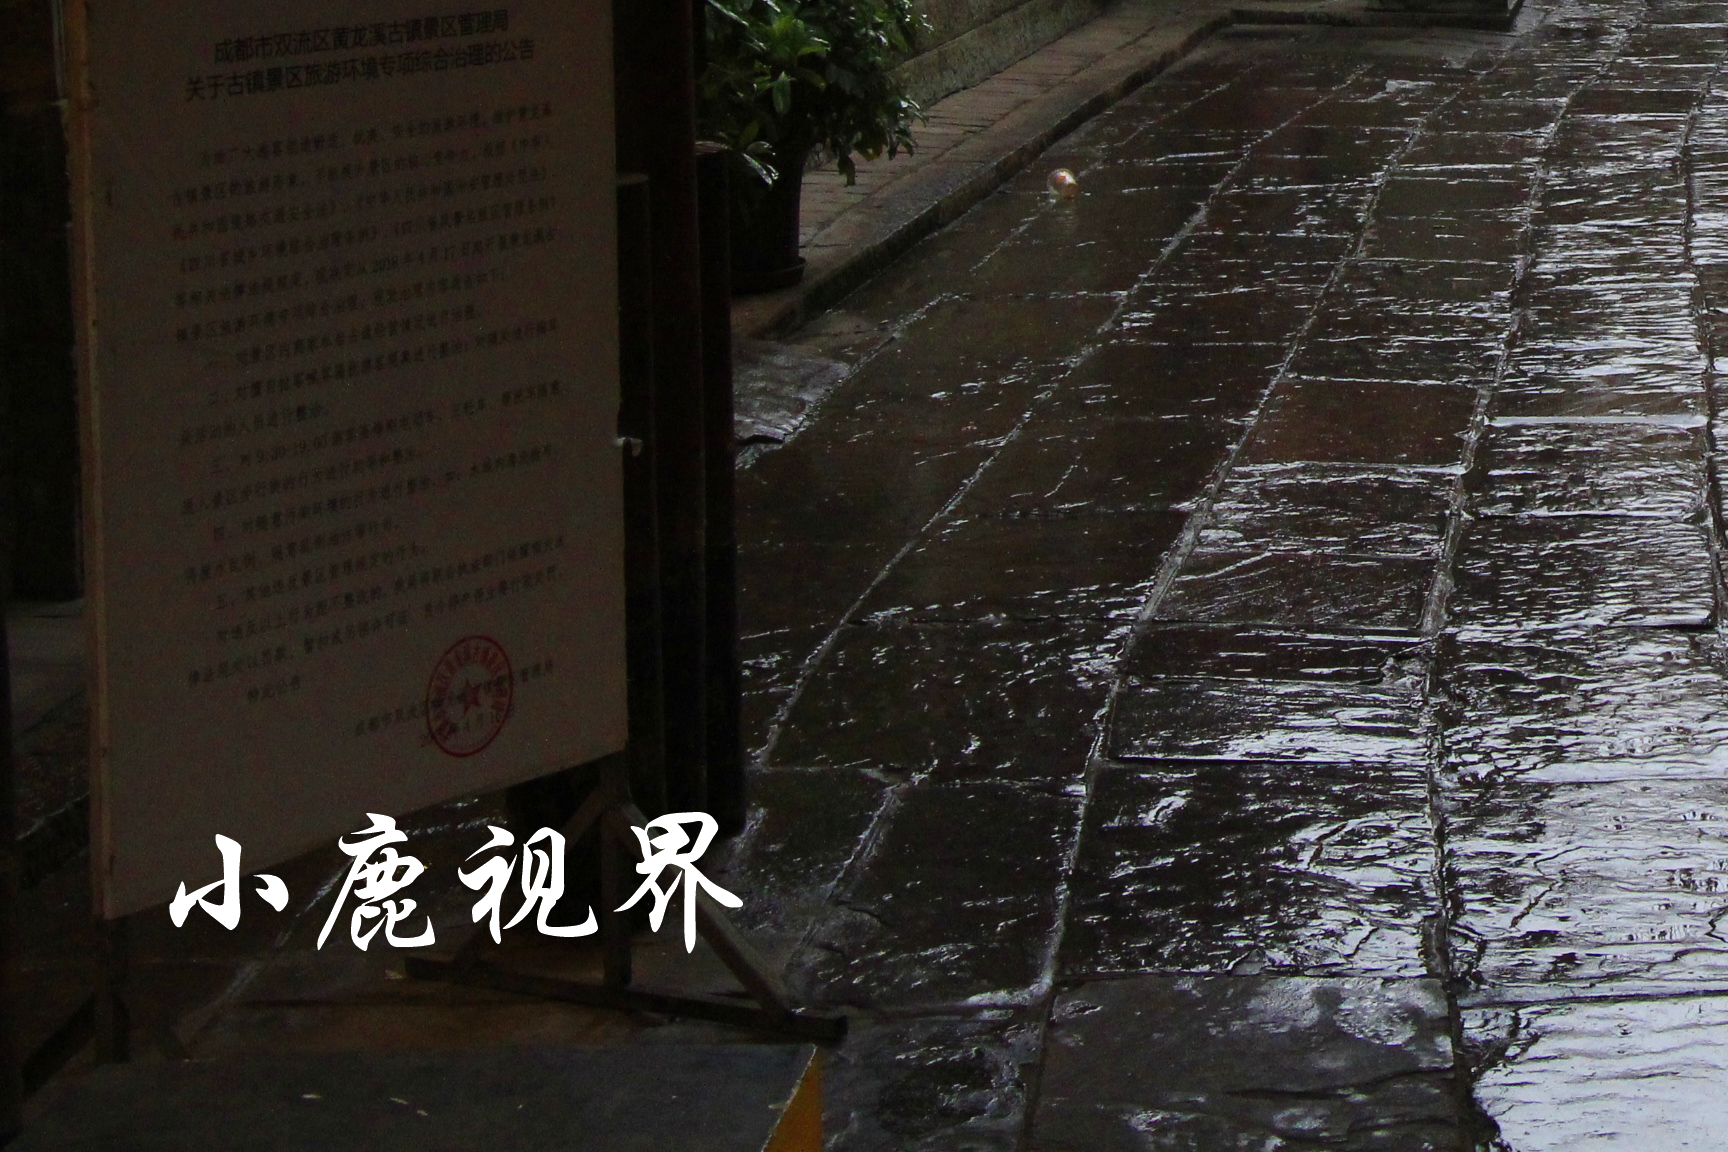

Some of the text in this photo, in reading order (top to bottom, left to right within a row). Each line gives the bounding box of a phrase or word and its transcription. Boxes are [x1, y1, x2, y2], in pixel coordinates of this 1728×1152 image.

[213, 9, 508, 65] 成都市双流区黄龙溪古镇景区管理局
[185, 37, 534, 102] 关于古镇景区旅游环境专项综合治理的公告
